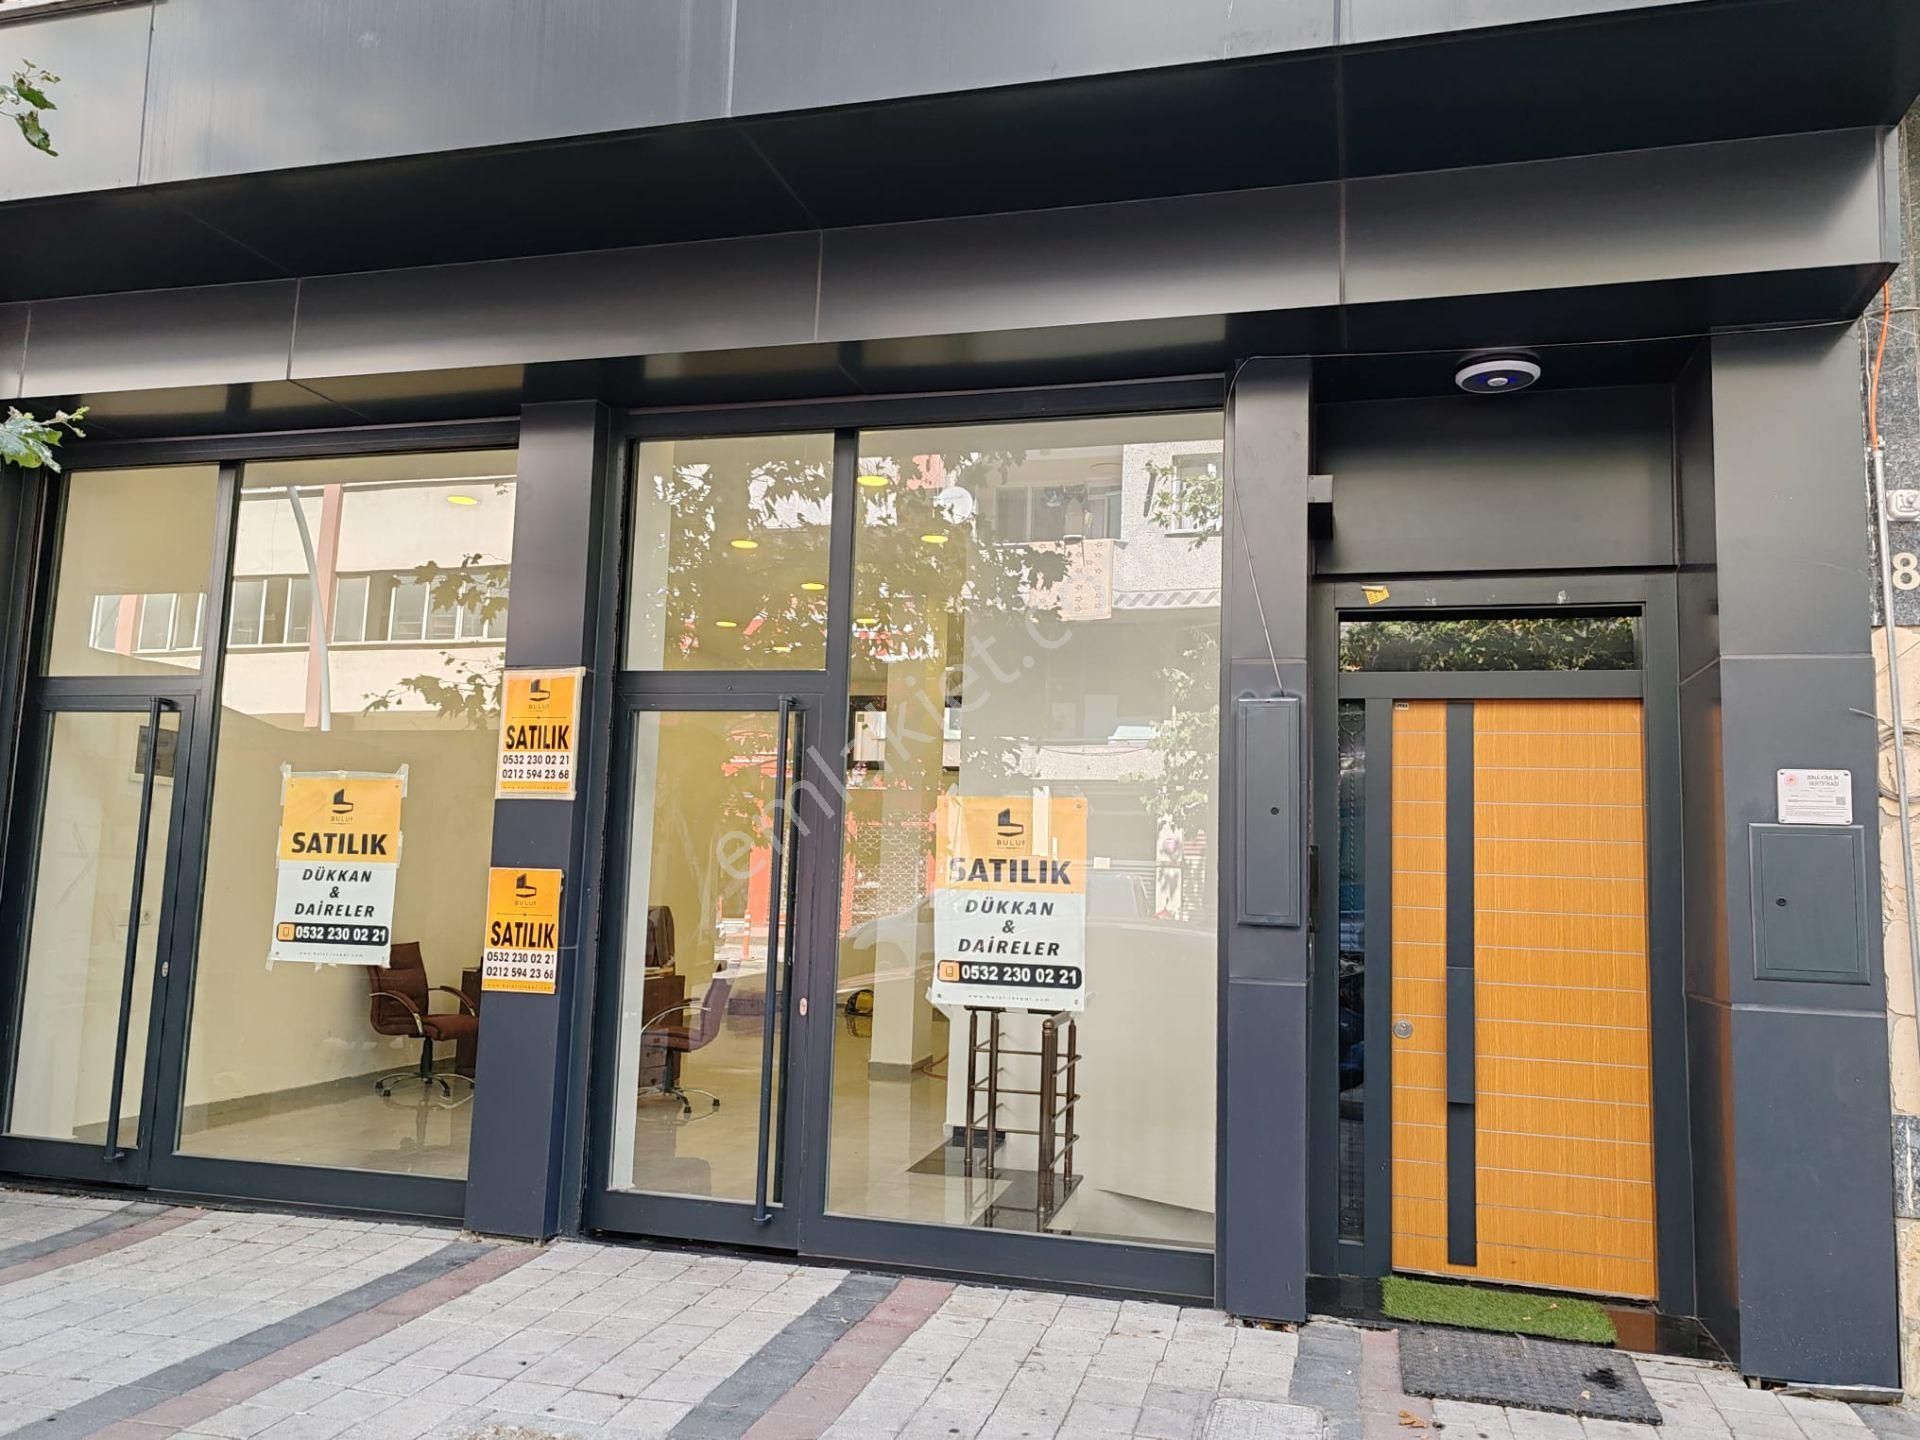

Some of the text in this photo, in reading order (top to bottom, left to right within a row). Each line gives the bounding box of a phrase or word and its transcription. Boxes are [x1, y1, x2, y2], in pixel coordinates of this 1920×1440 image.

[1893, 552, 1920, 590] 8
[505, 725, 569, 750] SATILIK
[502, 754, 569, 765] 0532 230 02 21
[502, 769, 569, 779] 0212 594 23 68
[291, 832, 388, 855] SATILIK
[302, 866, 372, 882] DÜKKAN
[950, 857, 1071, 885] SATILIK
[329, 885, 340, 898] &
[294, 900, 375, 918] DAİRELER
[965, 897, 1054, 916] DÜKKAN
[295, 925, 386, 942] 0532 230 02 21
[490, 921, 555, 948] SATILIK
[1002, 919, 1015, 933] &
[958, 936, 1060, 956] DAİRELER
[486, 951, 554, 964] 0532 230 02 21
[486, 966, 554, 979] 0212 594 23 68
[961, 964, 1077, 984] 0532 230 02 21
